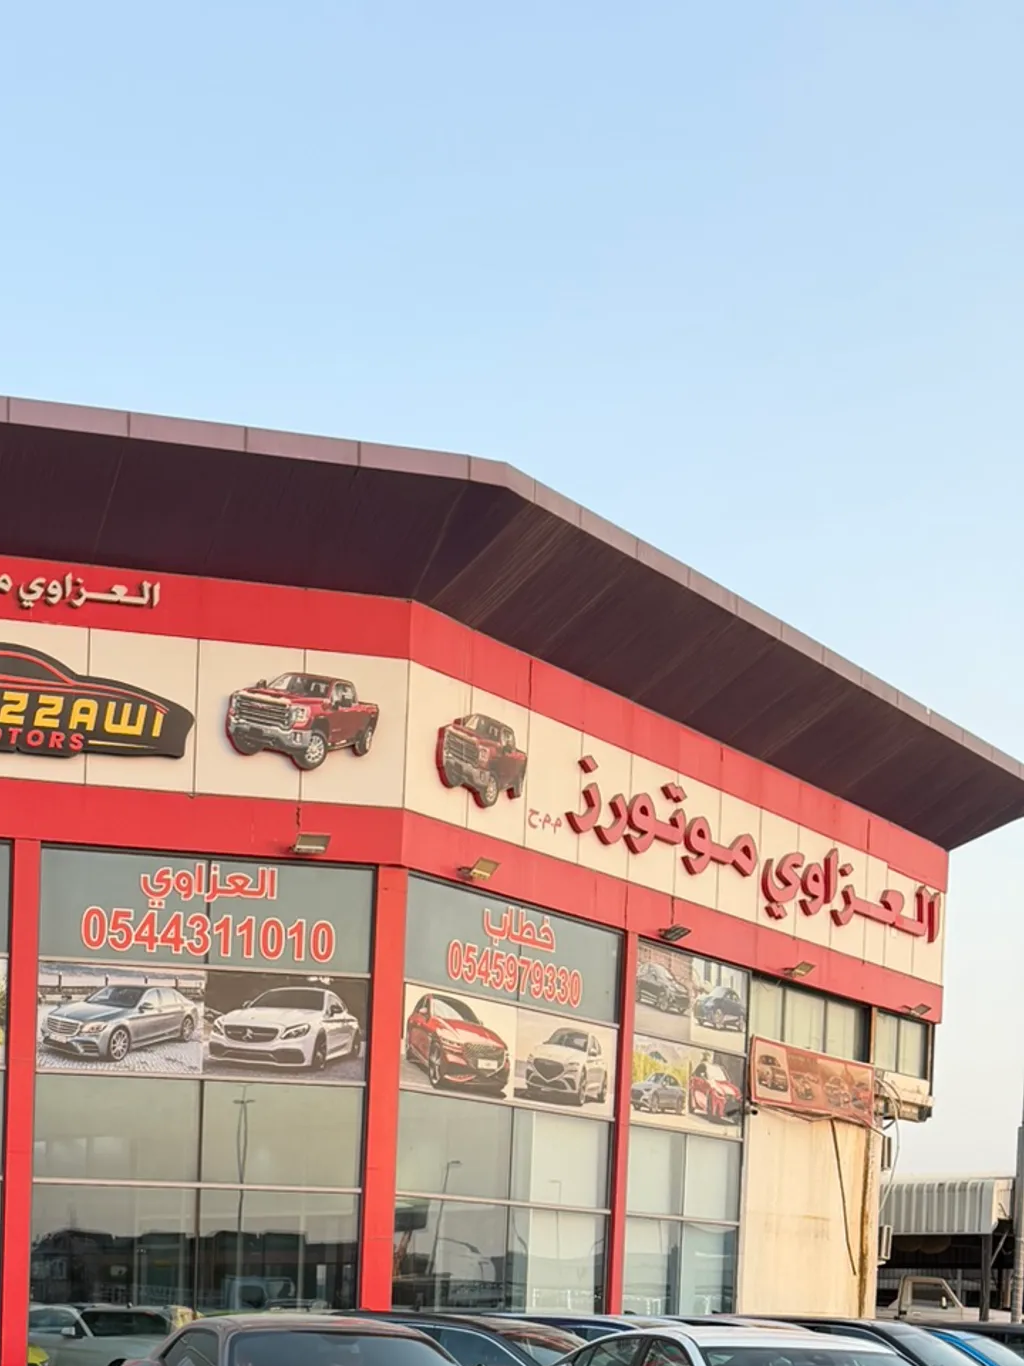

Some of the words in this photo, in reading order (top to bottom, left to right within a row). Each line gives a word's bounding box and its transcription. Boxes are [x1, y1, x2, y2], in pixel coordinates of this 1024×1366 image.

[17, 572, 161, 608] العزاوي
[564, 754, 758, 878] موتورز
[139, 862, 277, 909] العزاوي
[761, 847, 942, 944] العزاوي
[81, 905, 337, 965] 0544311010
[483, 905, 556, 953] خطاب
[447, 938, 583, 1009] 0545979330
